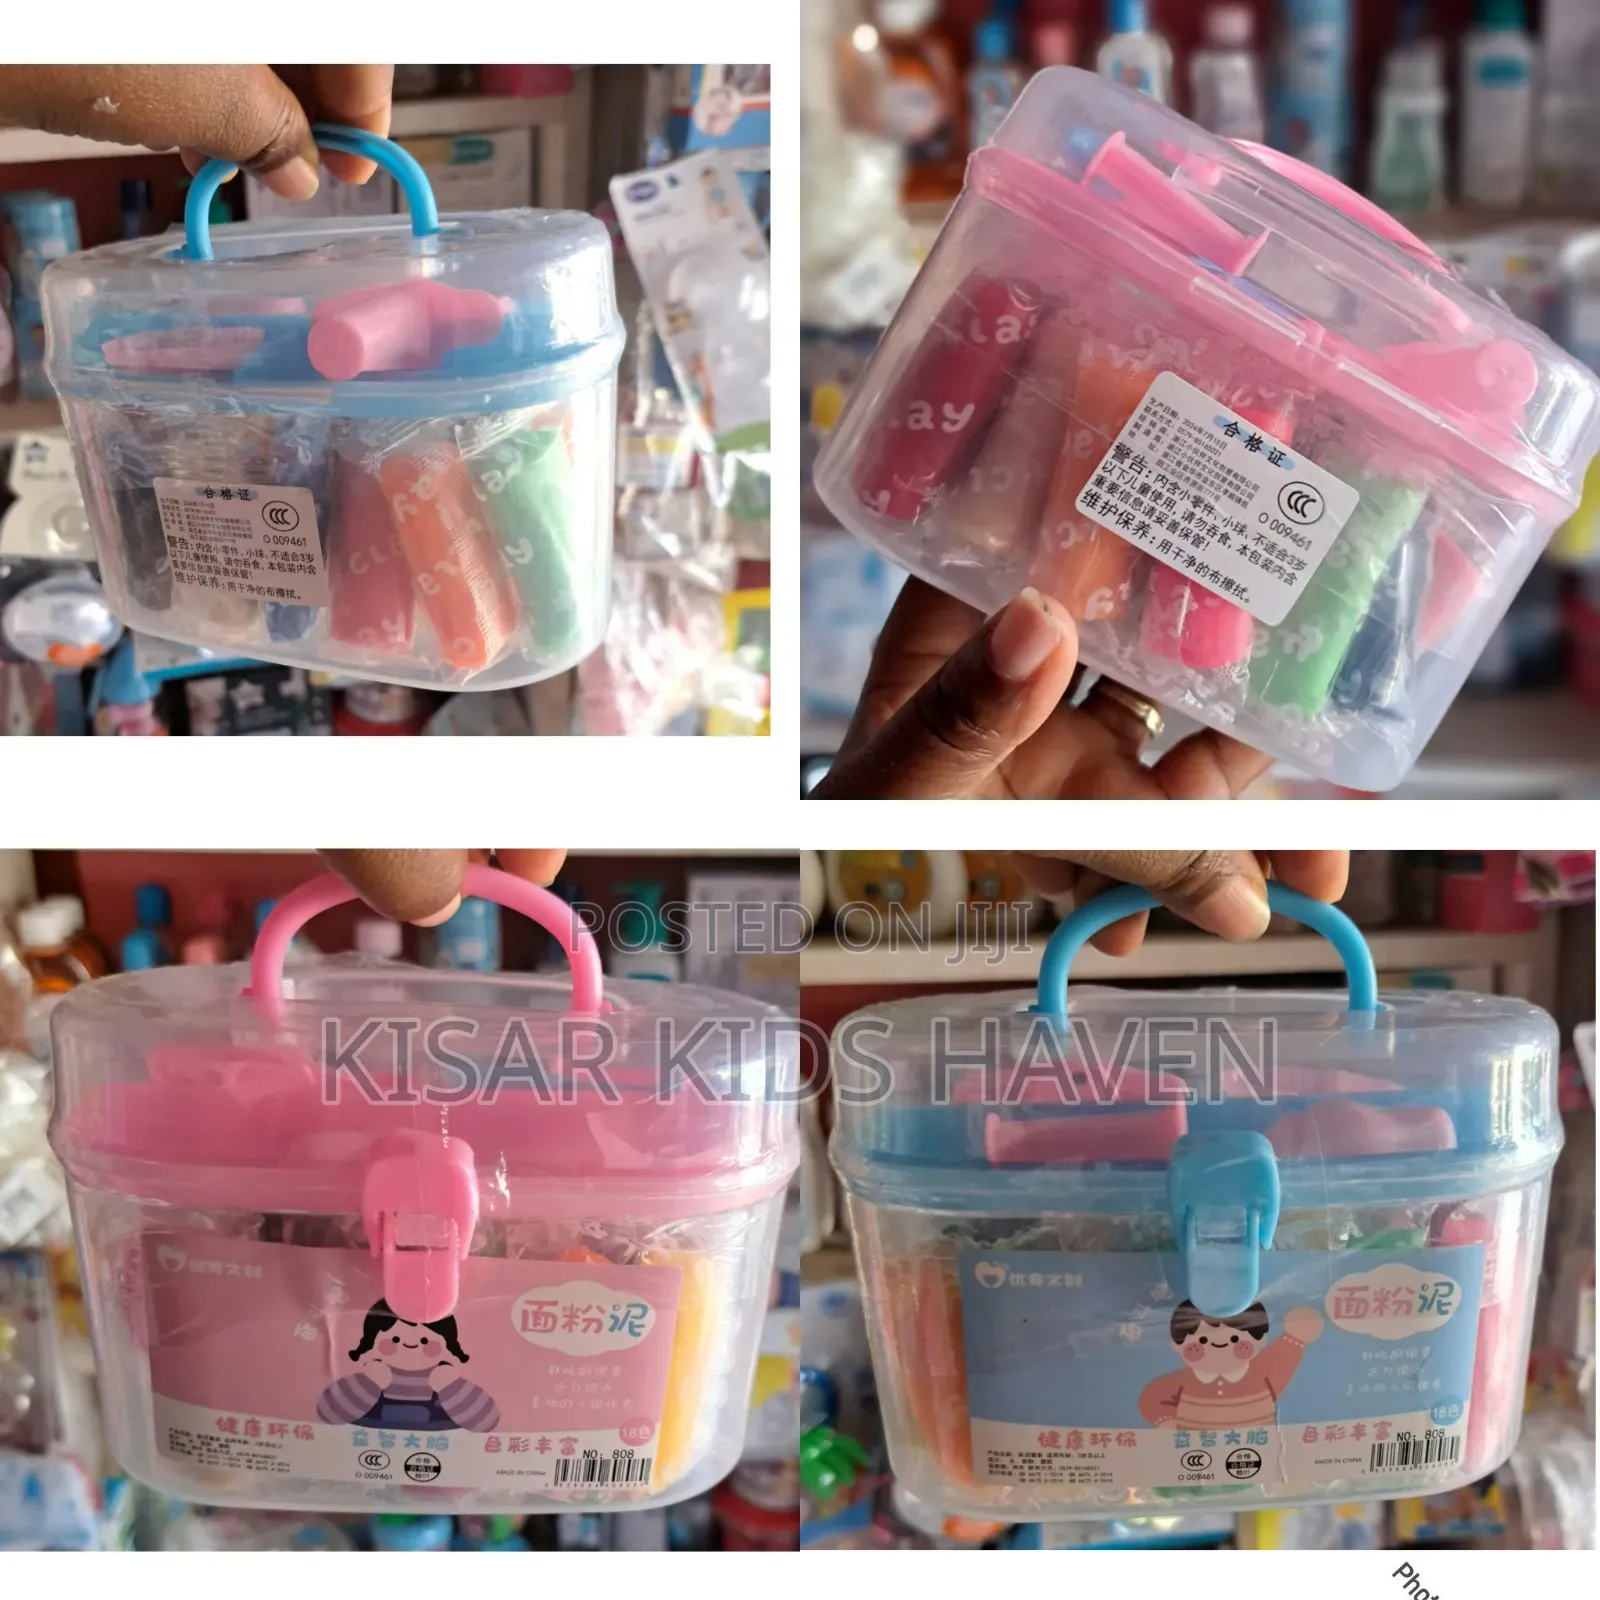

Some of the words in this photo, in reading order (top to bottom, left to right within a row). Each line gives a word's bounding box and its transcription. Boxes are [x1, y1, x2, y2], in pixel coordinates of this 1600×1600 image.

[1219, 416, 1289, 469] 合格证
[202, 485, 251, 501] 合格证
[272, 534, 306, 547] 009461
[1267, 517, 1313, 552] 009461
[1333, 1281, 1455, 1320] 面粉泥
[520, 1300, 649, 1338] 面粉泥
[1432, 1404, 1459, 1419] 18色
[215, 1416, 317, 1442] 健康环保
[352, 1428, 449, 1450] 益智大脑
[621, 1425, 650, 1439] 18色
[1172, 1429, 1269, 1448] 益智大脑
[1302, 1421, 1393, 1444] 色彩丰富
[1424, 1428, 1445, 1439] 808
[484, 1435, 580, 1456] 色彩丰富
[1037, 1429, 1138, 1451] 健康环保
[612, 1449, 634, 1459] 808
[364, 1472, 393, 1480] 009461
